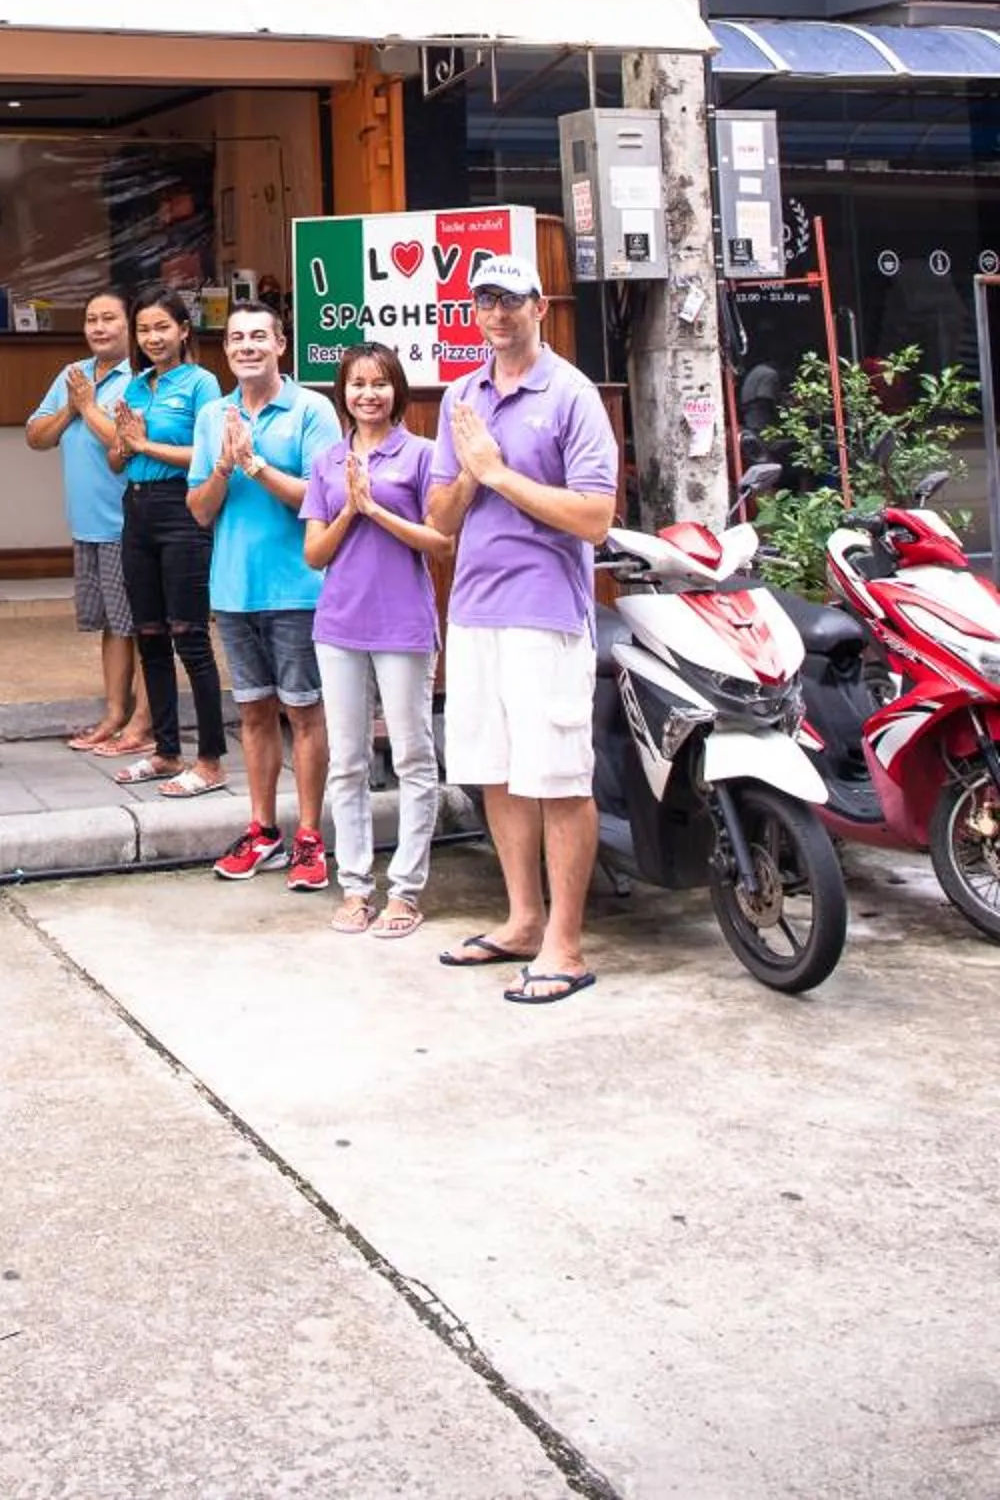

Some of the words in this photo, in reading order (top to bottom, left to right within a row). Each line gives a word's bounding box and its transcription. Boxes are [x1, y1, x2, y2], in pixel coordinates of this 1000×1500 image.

[311, 258, 328, 295] I
[321, 302, 473, 328] SPAGHETT
[409, 344, 423, 361] &
